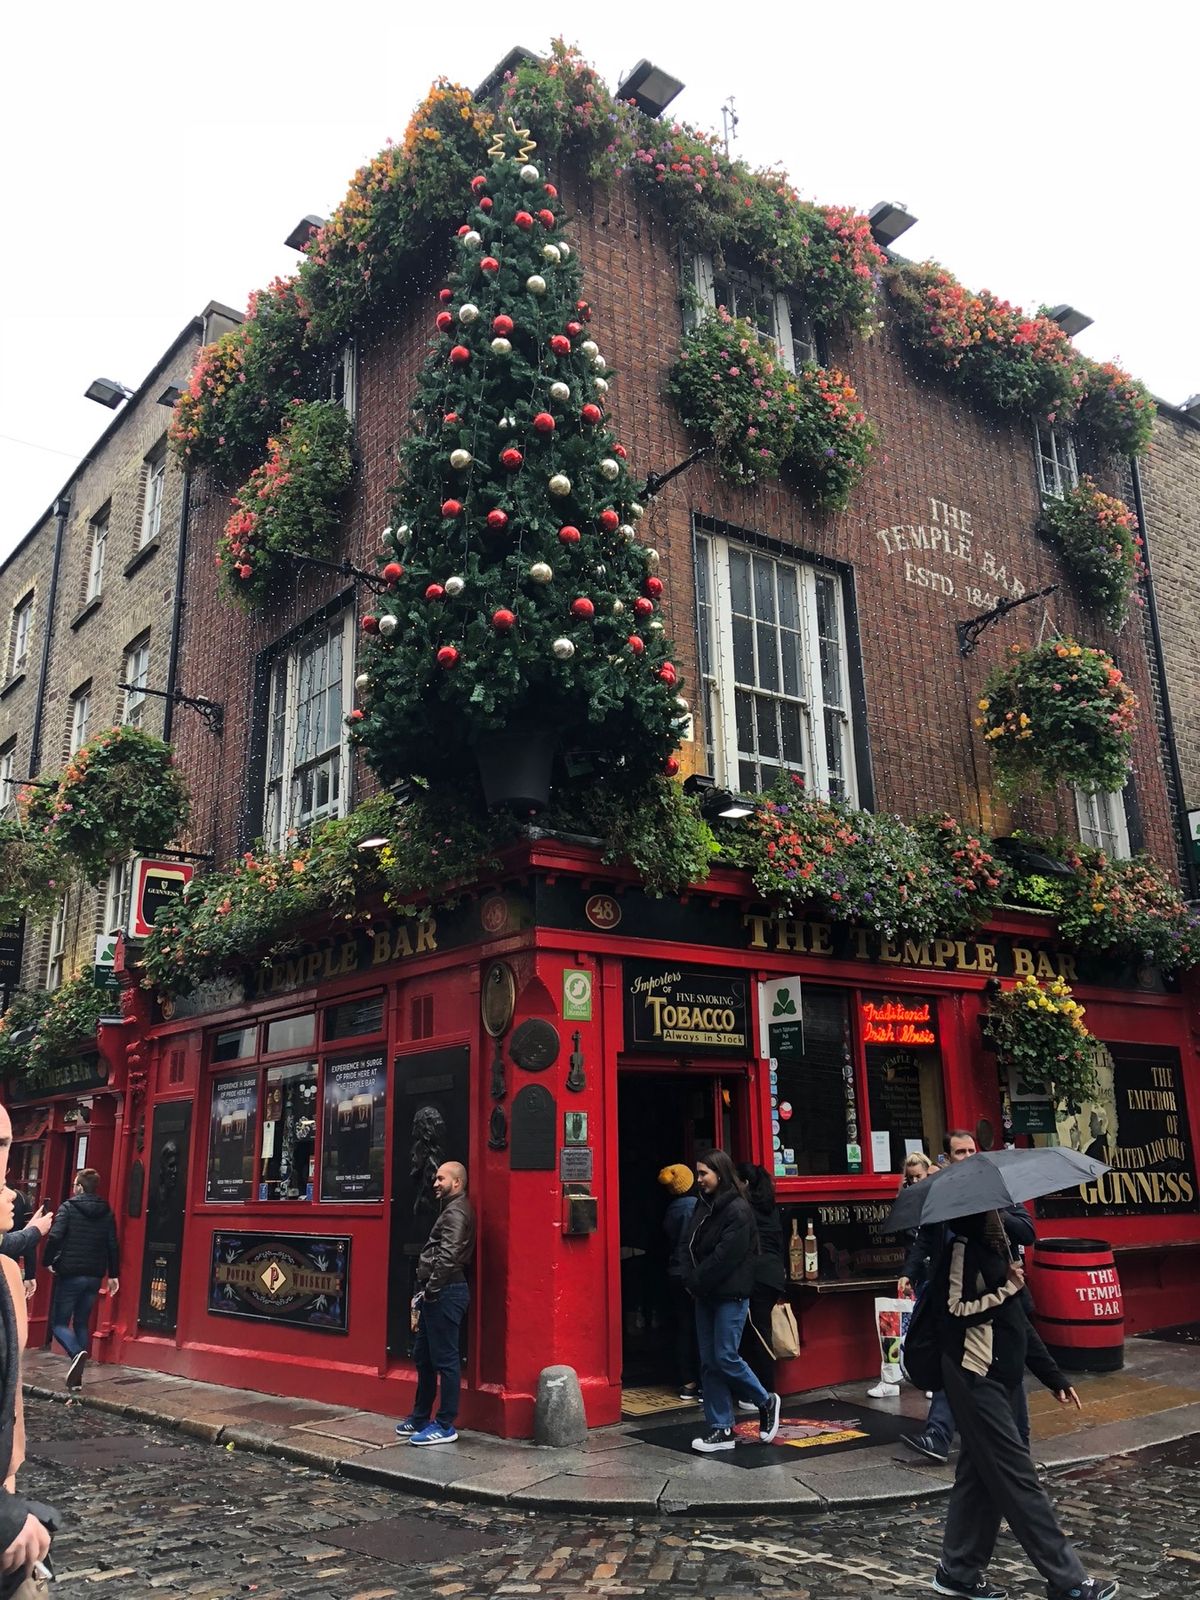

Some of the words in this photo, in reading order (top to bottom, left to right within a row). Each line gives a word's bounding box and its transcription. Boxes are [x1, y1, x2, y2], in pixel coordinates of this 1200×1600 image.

[929, 497, 974, 537] THE
[876, 525, 972, 563] TEMPLE
[982, 550, 1025, 600] BAR
[904, 560, 958, 599] ESTD.
[148, 888, 180, 897] GUINNESS
[486, 904, 502, 929] 48
[592, 899, 614, 921] 48
[255, 941, 359, 996] TEMPLE
[371, 918, 438, 965] BAR
[743, 914, 833, 955] THE
[849, 928, 998, 972] TEMPLE
[1012, 947, 1079, 980] BAR
[630, 971, 681, 995] Importers
[662, 986, 672, 994] OF
[676, 992, 695, 1003] FINE
[696, 994, 734, 1006] SMOKING
[645, 996, 735, 1036] TOBACCO
[864, 1003, 930, 1020] Traditional
[664, 1030, 700, 1041] Always
[704, 1032, 713, 1041] in
[716, 1033, 743, 1044] Stock
[864, 1022, 895, 1041] Irish
[900, 1025, 935, 1043] Music
[331, 1061, 359, 1072] EXPERIENCE
[366, 1057, 382, 1067] SURGE
[343, 1071, 357, 1080] PRIDE
[371, 1068, 377, 1076] AT
[347, 1080, 364, 1088] TEMPLE
[1151, 1067, 1174, 1088] THE
[1127, 1089, 1178, 1112] EMPEROR
[1166, 1115, 1179, 1135] OF
[1102, 1145, 1146, 1169] MALTED
[1145, 1138, 1187, 1165] LIQUORS
[1079, 1172, 1194, 1205] GUINNESS
[818, 1206, 850, 1224] THE
[226, 1267, 256, 1281] POWERS
[270, 1266, 280, 1290] P
[292, 1272, 332, 1290] WHISKEY
[1087, 1269, 1114, 1284] THE
[1093, 1300, 1120, 1316] BAR
